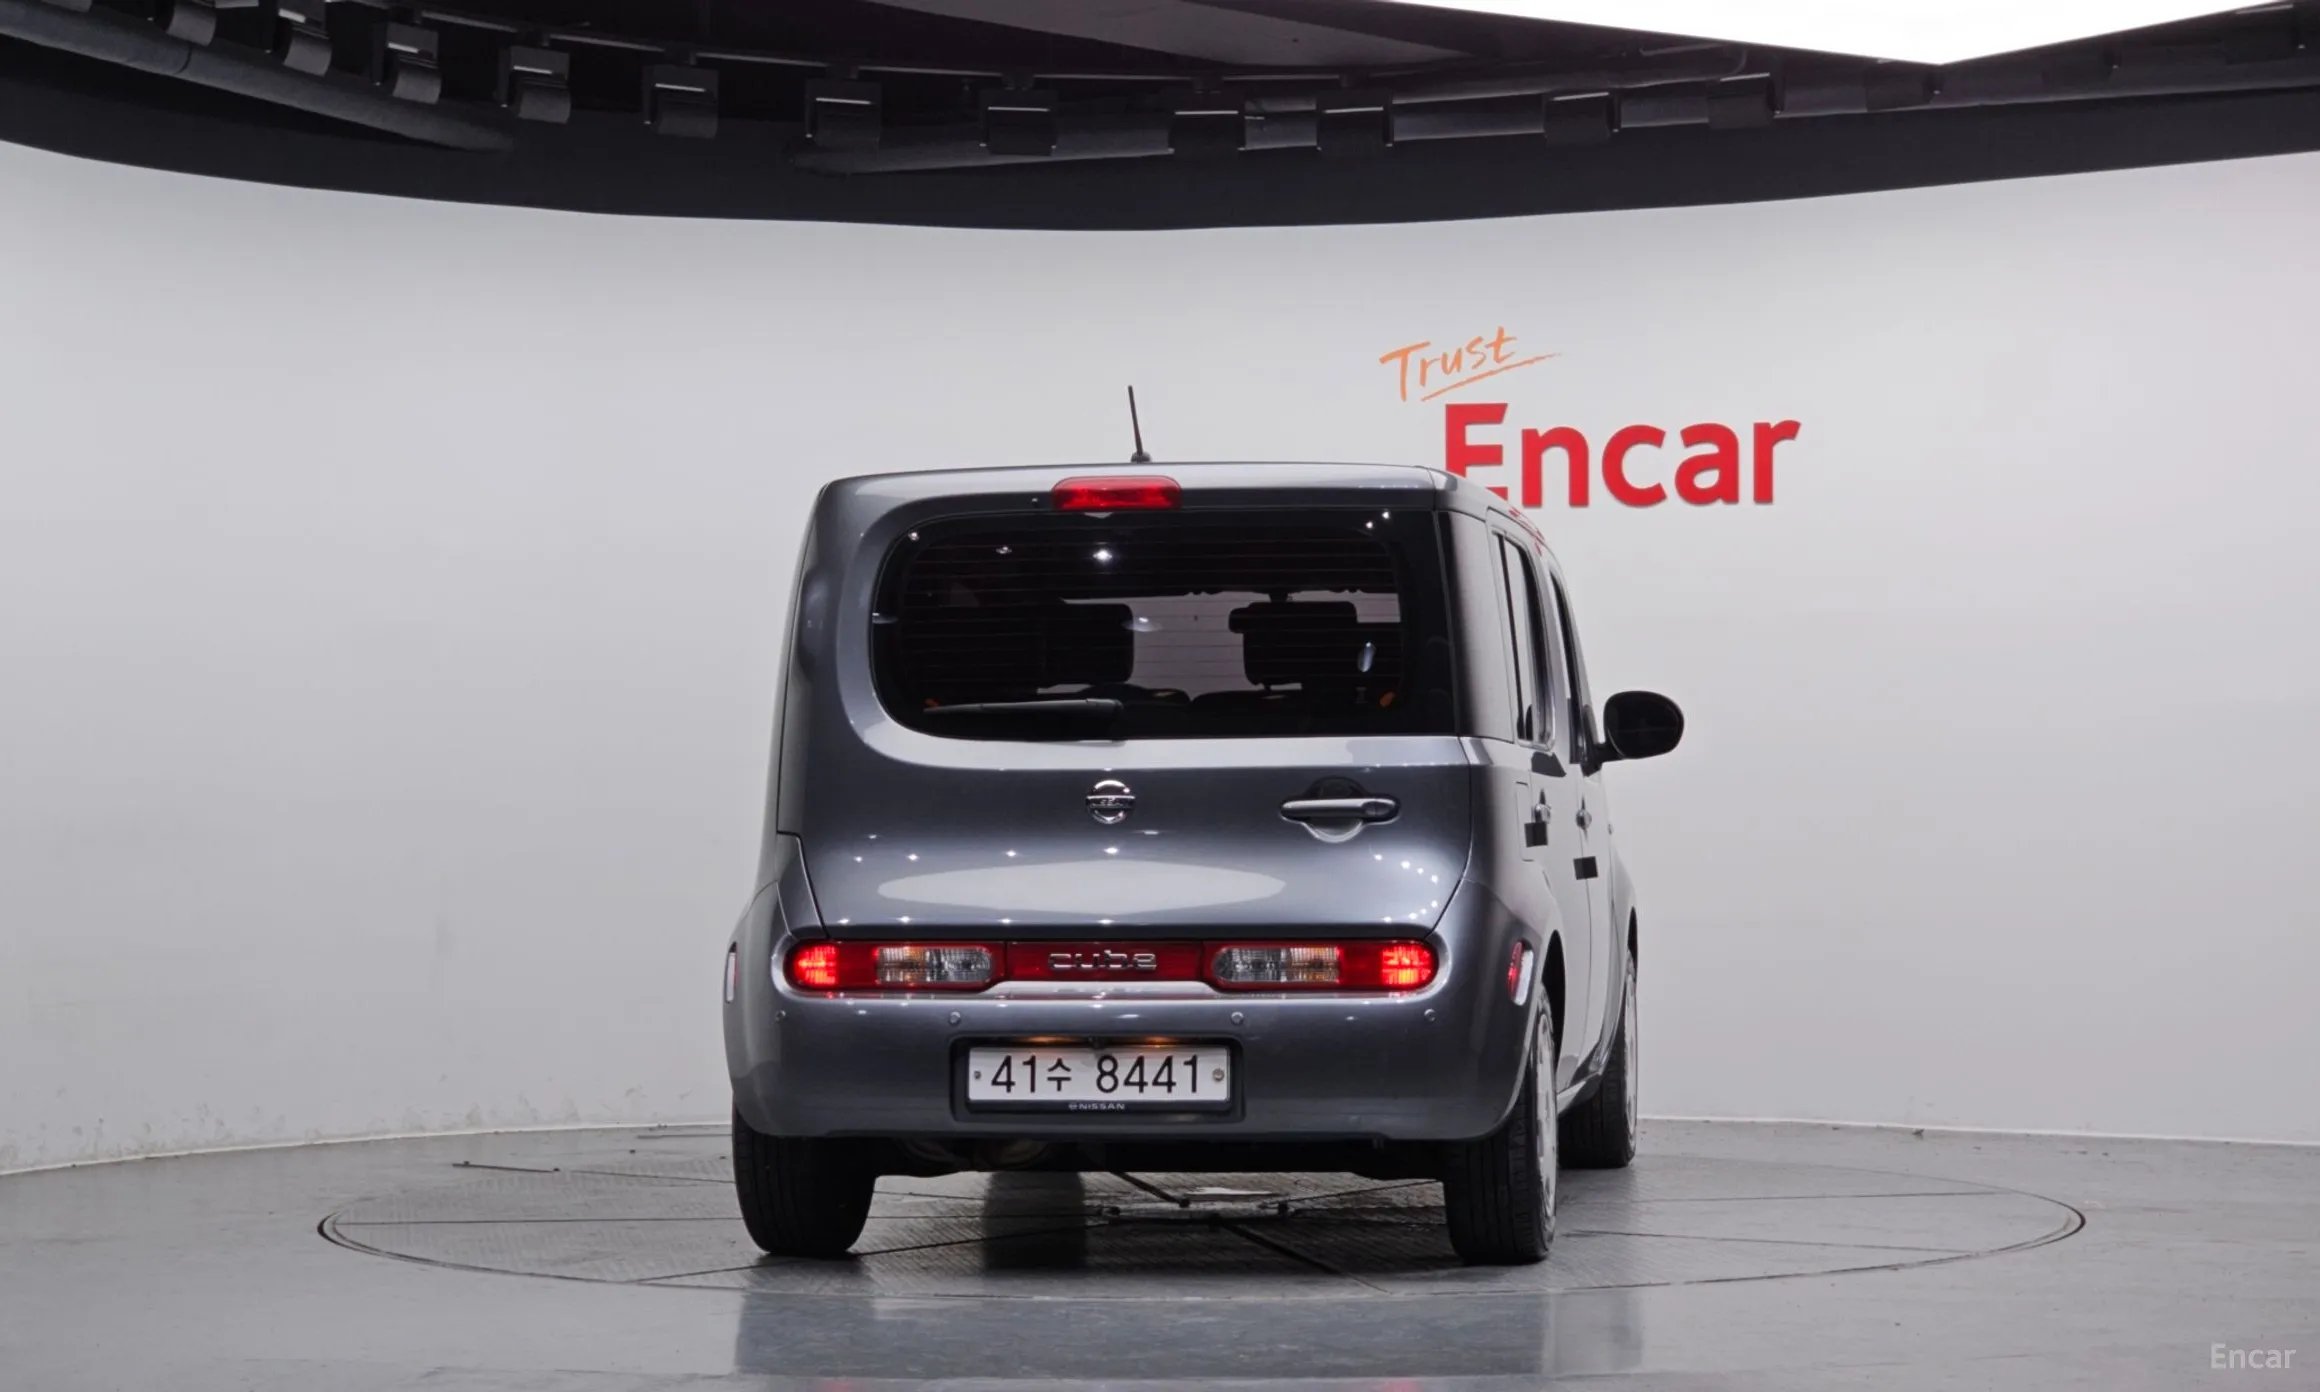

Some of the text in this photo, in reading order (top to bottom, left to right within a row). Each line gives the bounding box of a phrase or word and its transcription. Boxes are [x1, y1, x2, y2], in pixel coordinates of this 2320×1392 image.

[1379, 326, 1518, 401] Trust
[1445, 402, 1801, 507] Encar
[1049, 950, 1157, 971] cube
[990, 1054, 1199, 1093] 41수 8441
[1078, 1102, 1126, 1110] NISSAN
